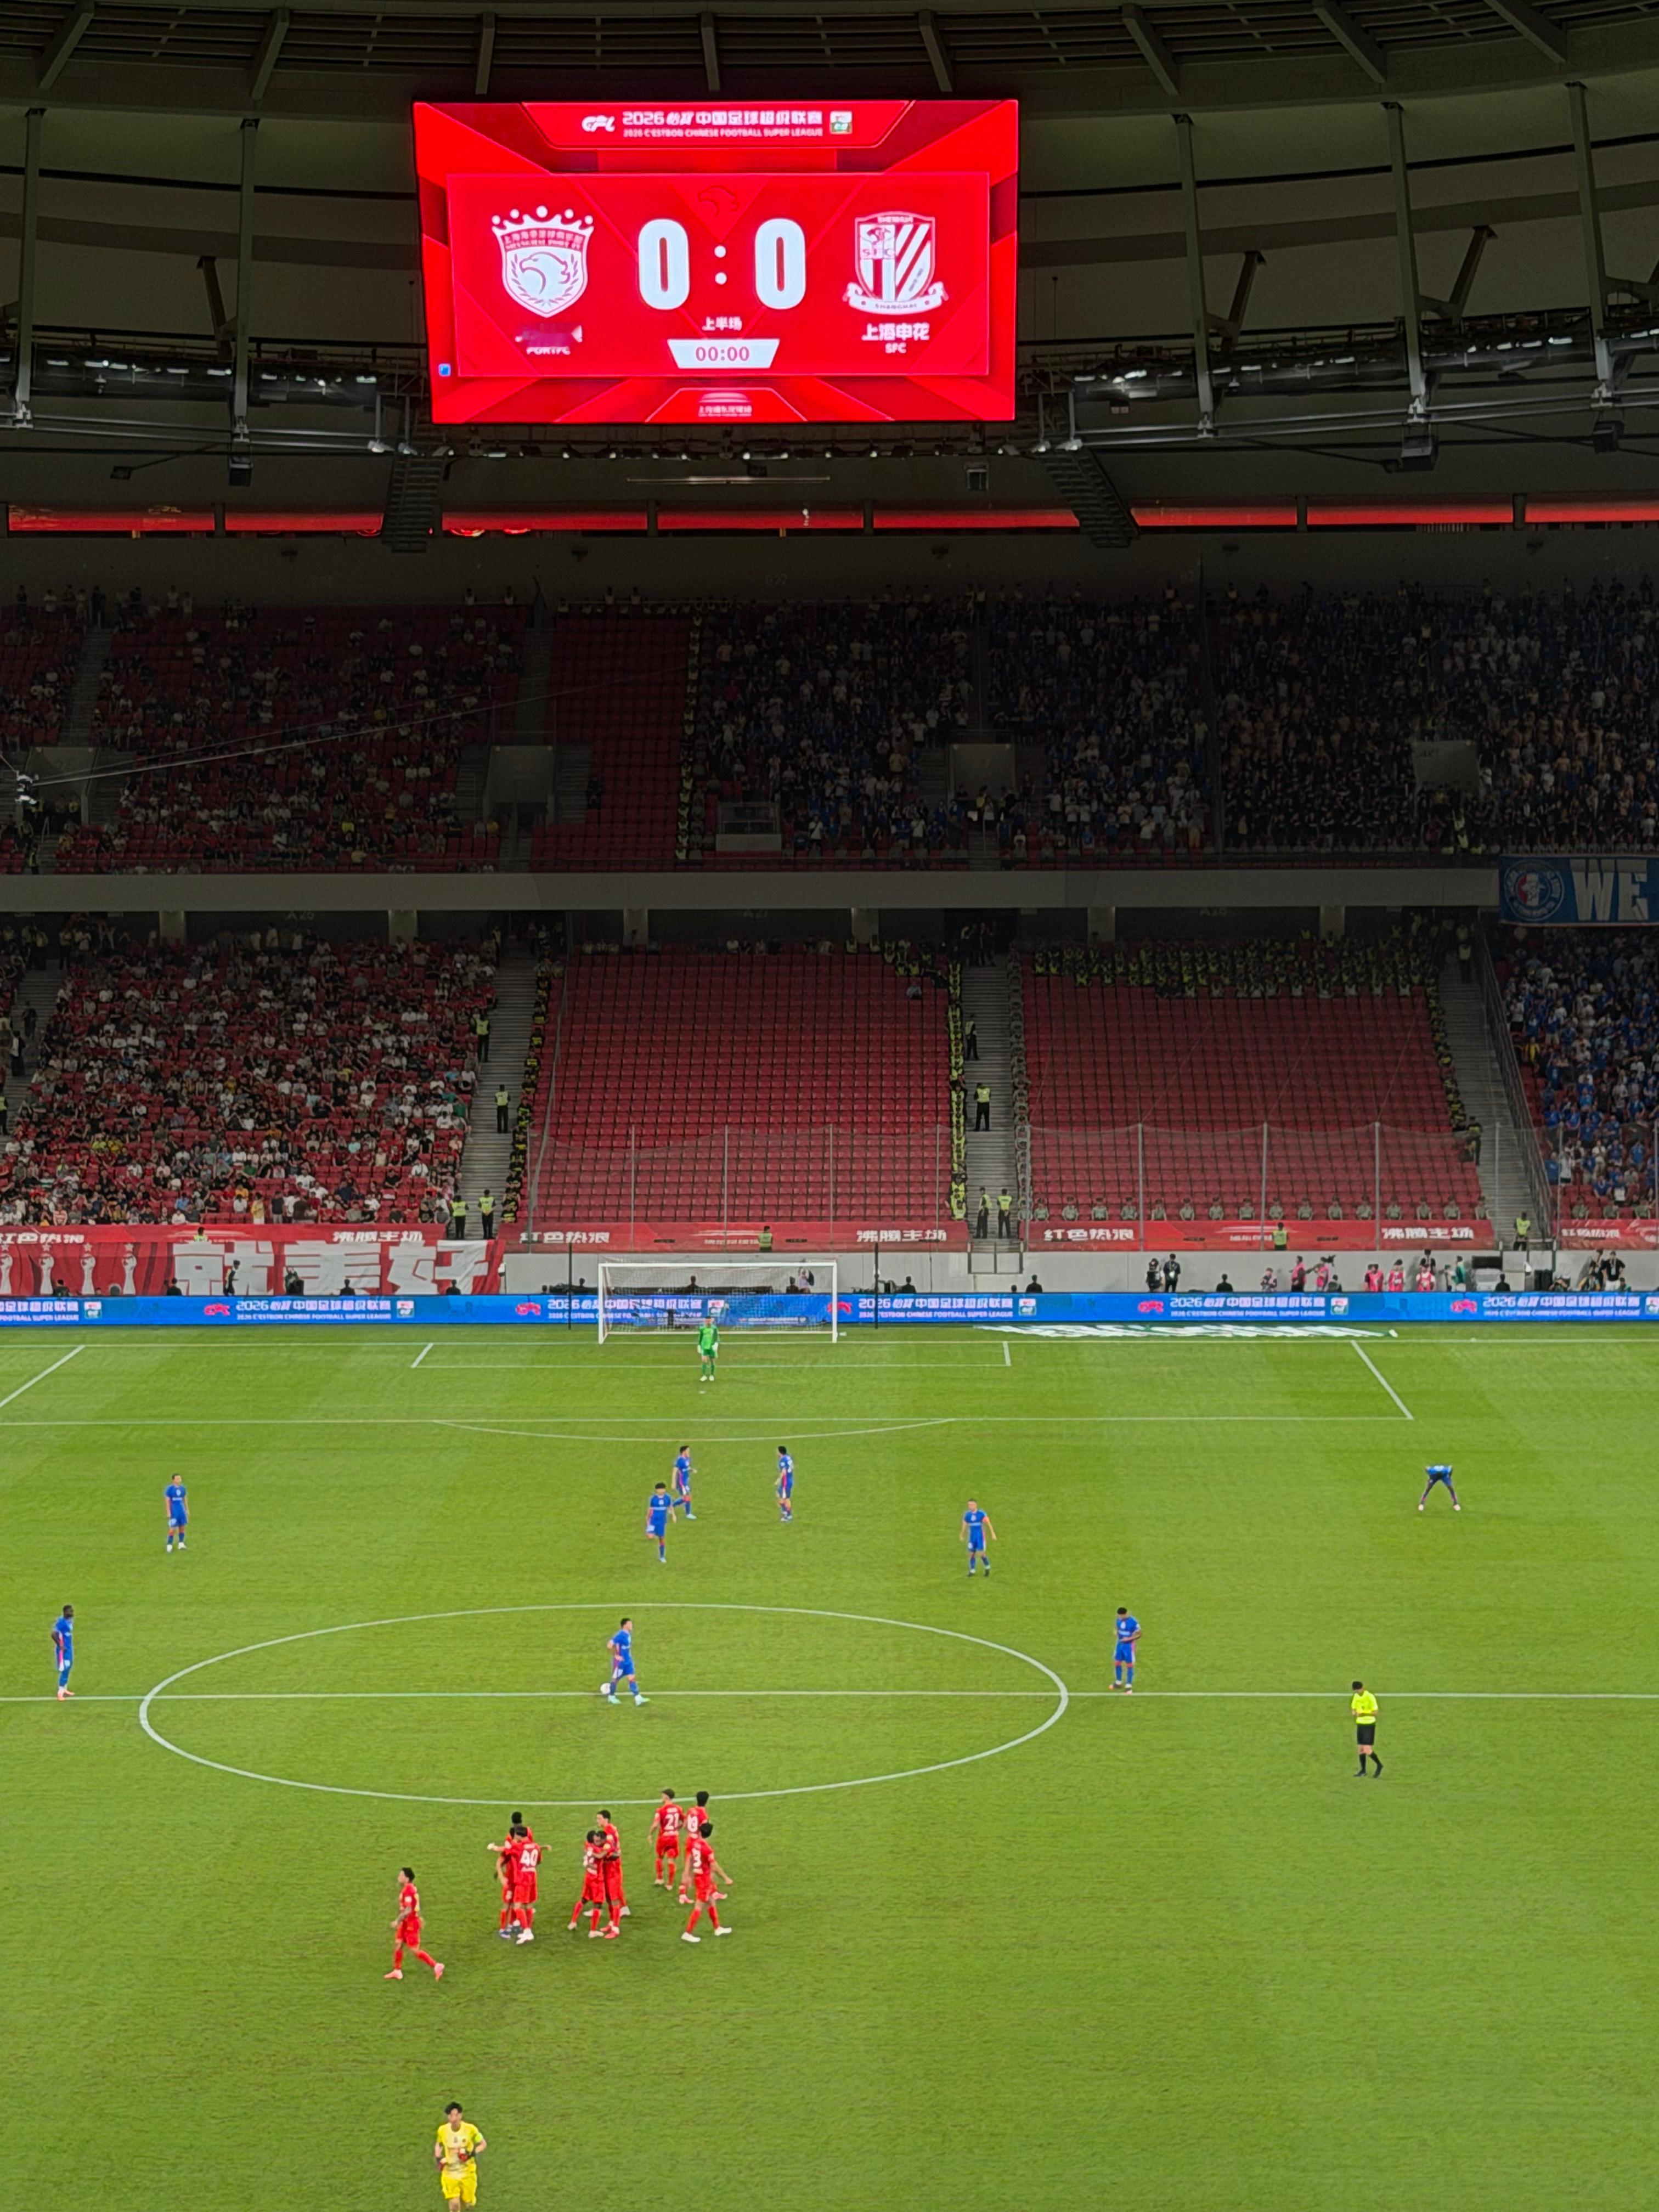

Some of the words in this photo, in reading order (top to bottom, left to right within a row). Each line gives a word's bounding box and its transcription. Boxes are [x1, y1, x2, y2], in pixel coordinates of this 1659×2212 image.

[638, 218, 690, 310] 0
[755, 218, 806, 310] 0
[702, 316, 742, 331] 上半场
[861, 323, 930, 341] 上海申花
[695, 346, 750, 362] 00:00
[885, 342, 907, 354] SFC
[1570, 859, 1648, 921] WE
[518, 1231, 610, 1243] 红色热浪
[856, 1229, 947, 1242] 沸腾主场
[1043, 1229, 1135, 1241] 红色热浪
[1381, 1227, 1474, 1239] 沸腾主场
[664, 1813, 680, 1831] 21
[520, 1849, 539, 1866] 40
